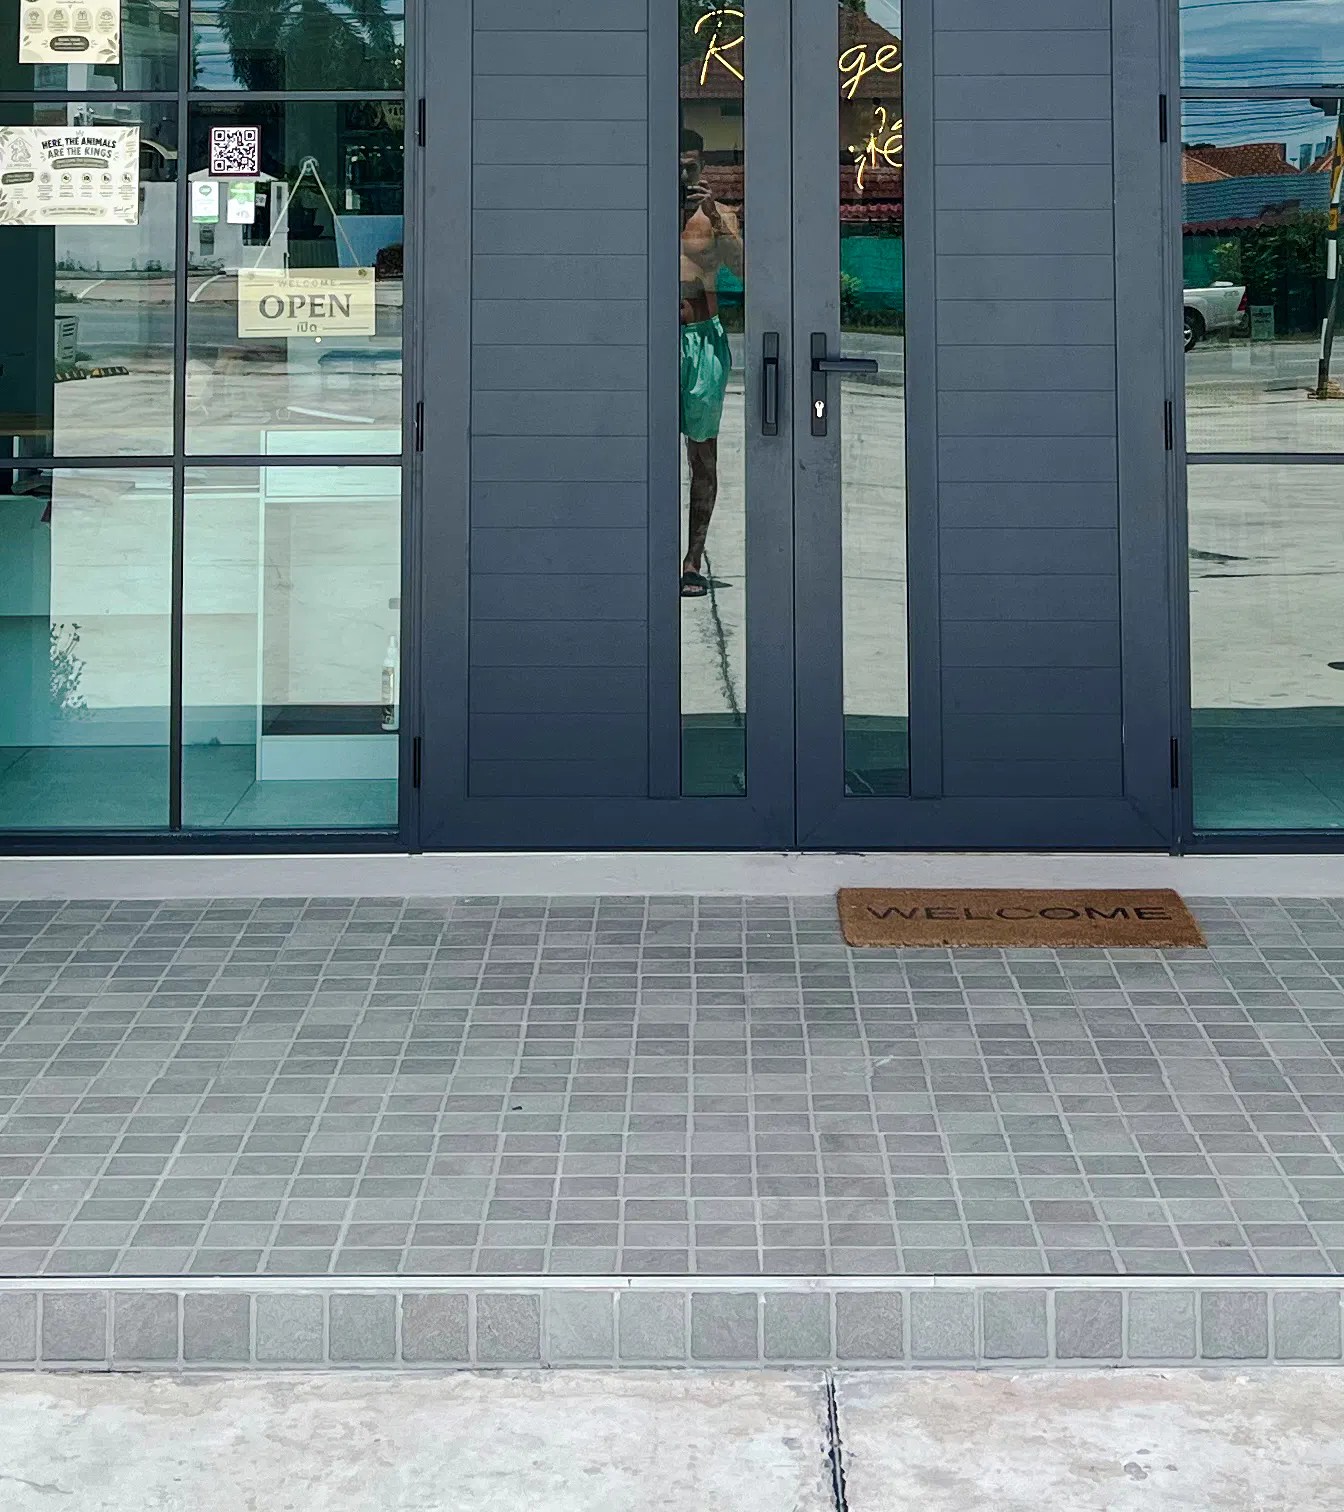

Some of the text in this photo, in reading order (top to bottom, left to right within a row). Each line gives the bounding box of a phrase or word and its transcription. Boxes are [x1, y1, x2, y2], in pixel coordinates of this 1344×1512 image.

[65, 137, 79, 146] THE
[81, 137, 117, 149] ANIMALS
[48, 148, 64, 159] ARE
[67, 147, 81, 156] THE
[84, 147, 113, 159] KINGS
[277, 279, 336, 288] WELCOME
[258, 293, 352, 319] OPEN
[865, 905, 1173, 921] WELCOME
